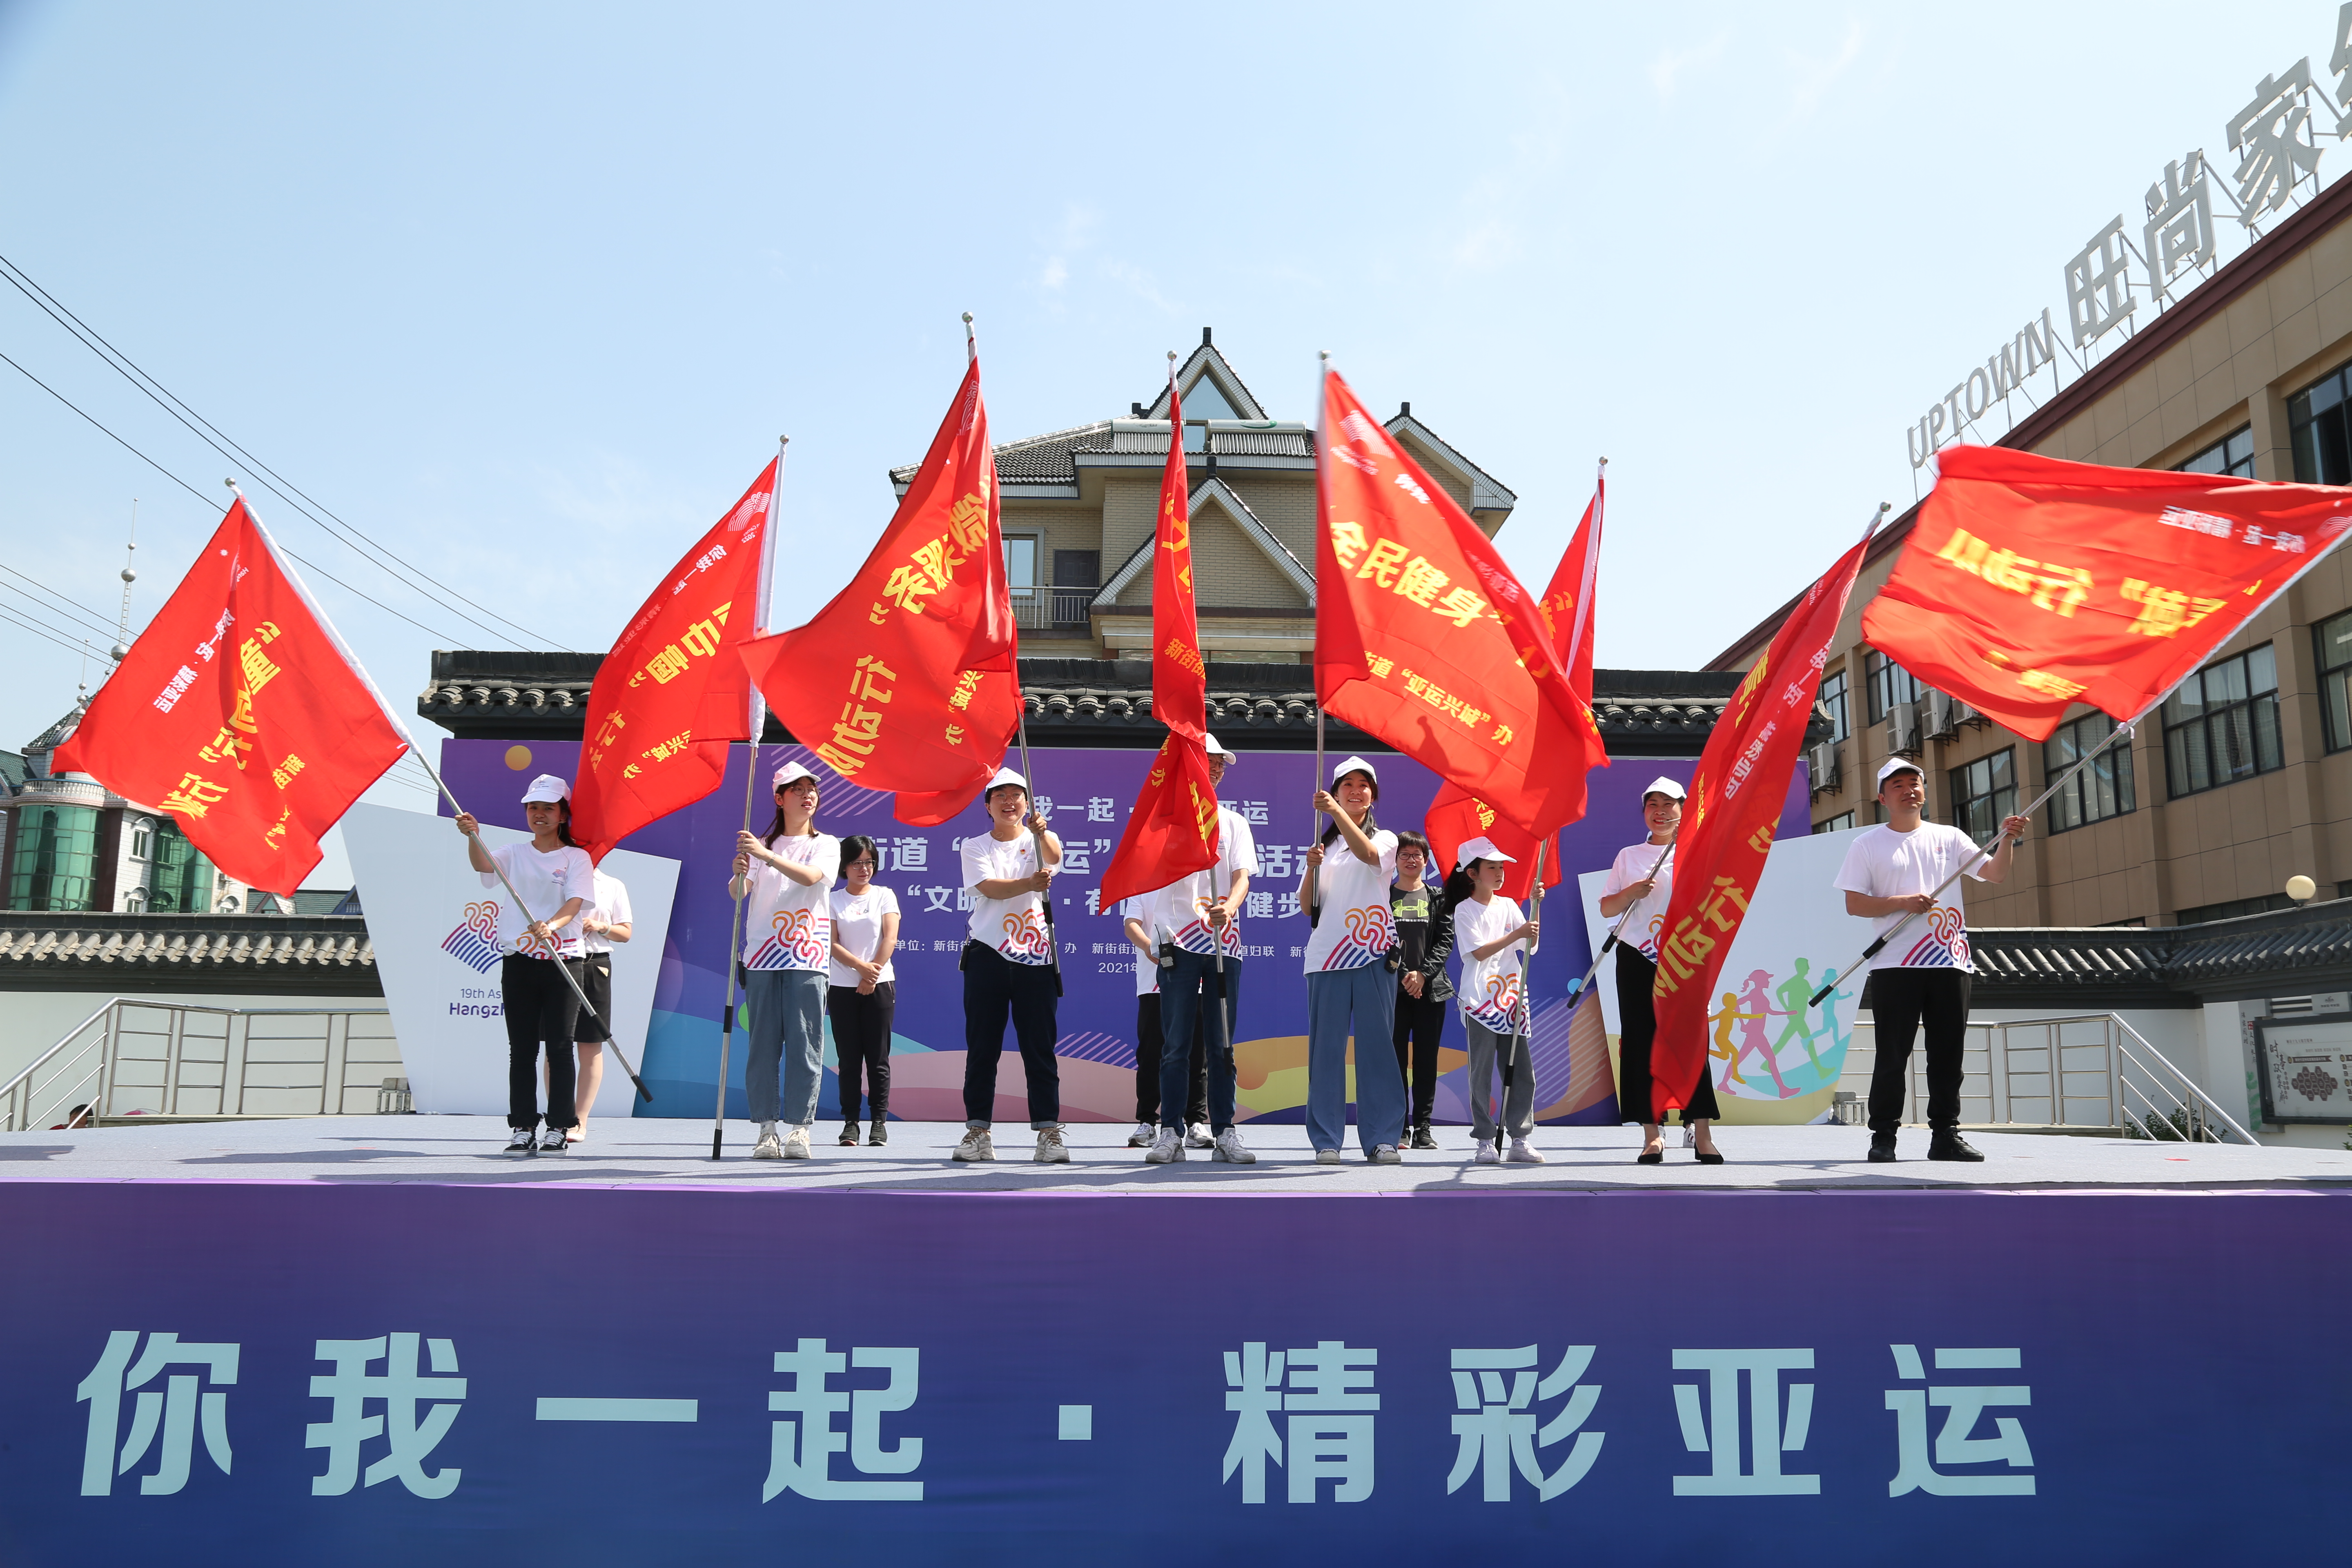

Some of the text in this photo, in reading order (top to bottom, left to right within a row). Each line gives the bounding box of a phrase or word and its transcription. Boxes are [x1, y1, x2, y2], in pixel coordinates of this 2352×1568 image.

[1907, 307, 2054, 469] UPTOWN
[460, 988, 485, 998] 19th
[76, 1330, 2036, 1504] 你我一起·精彩亚运
